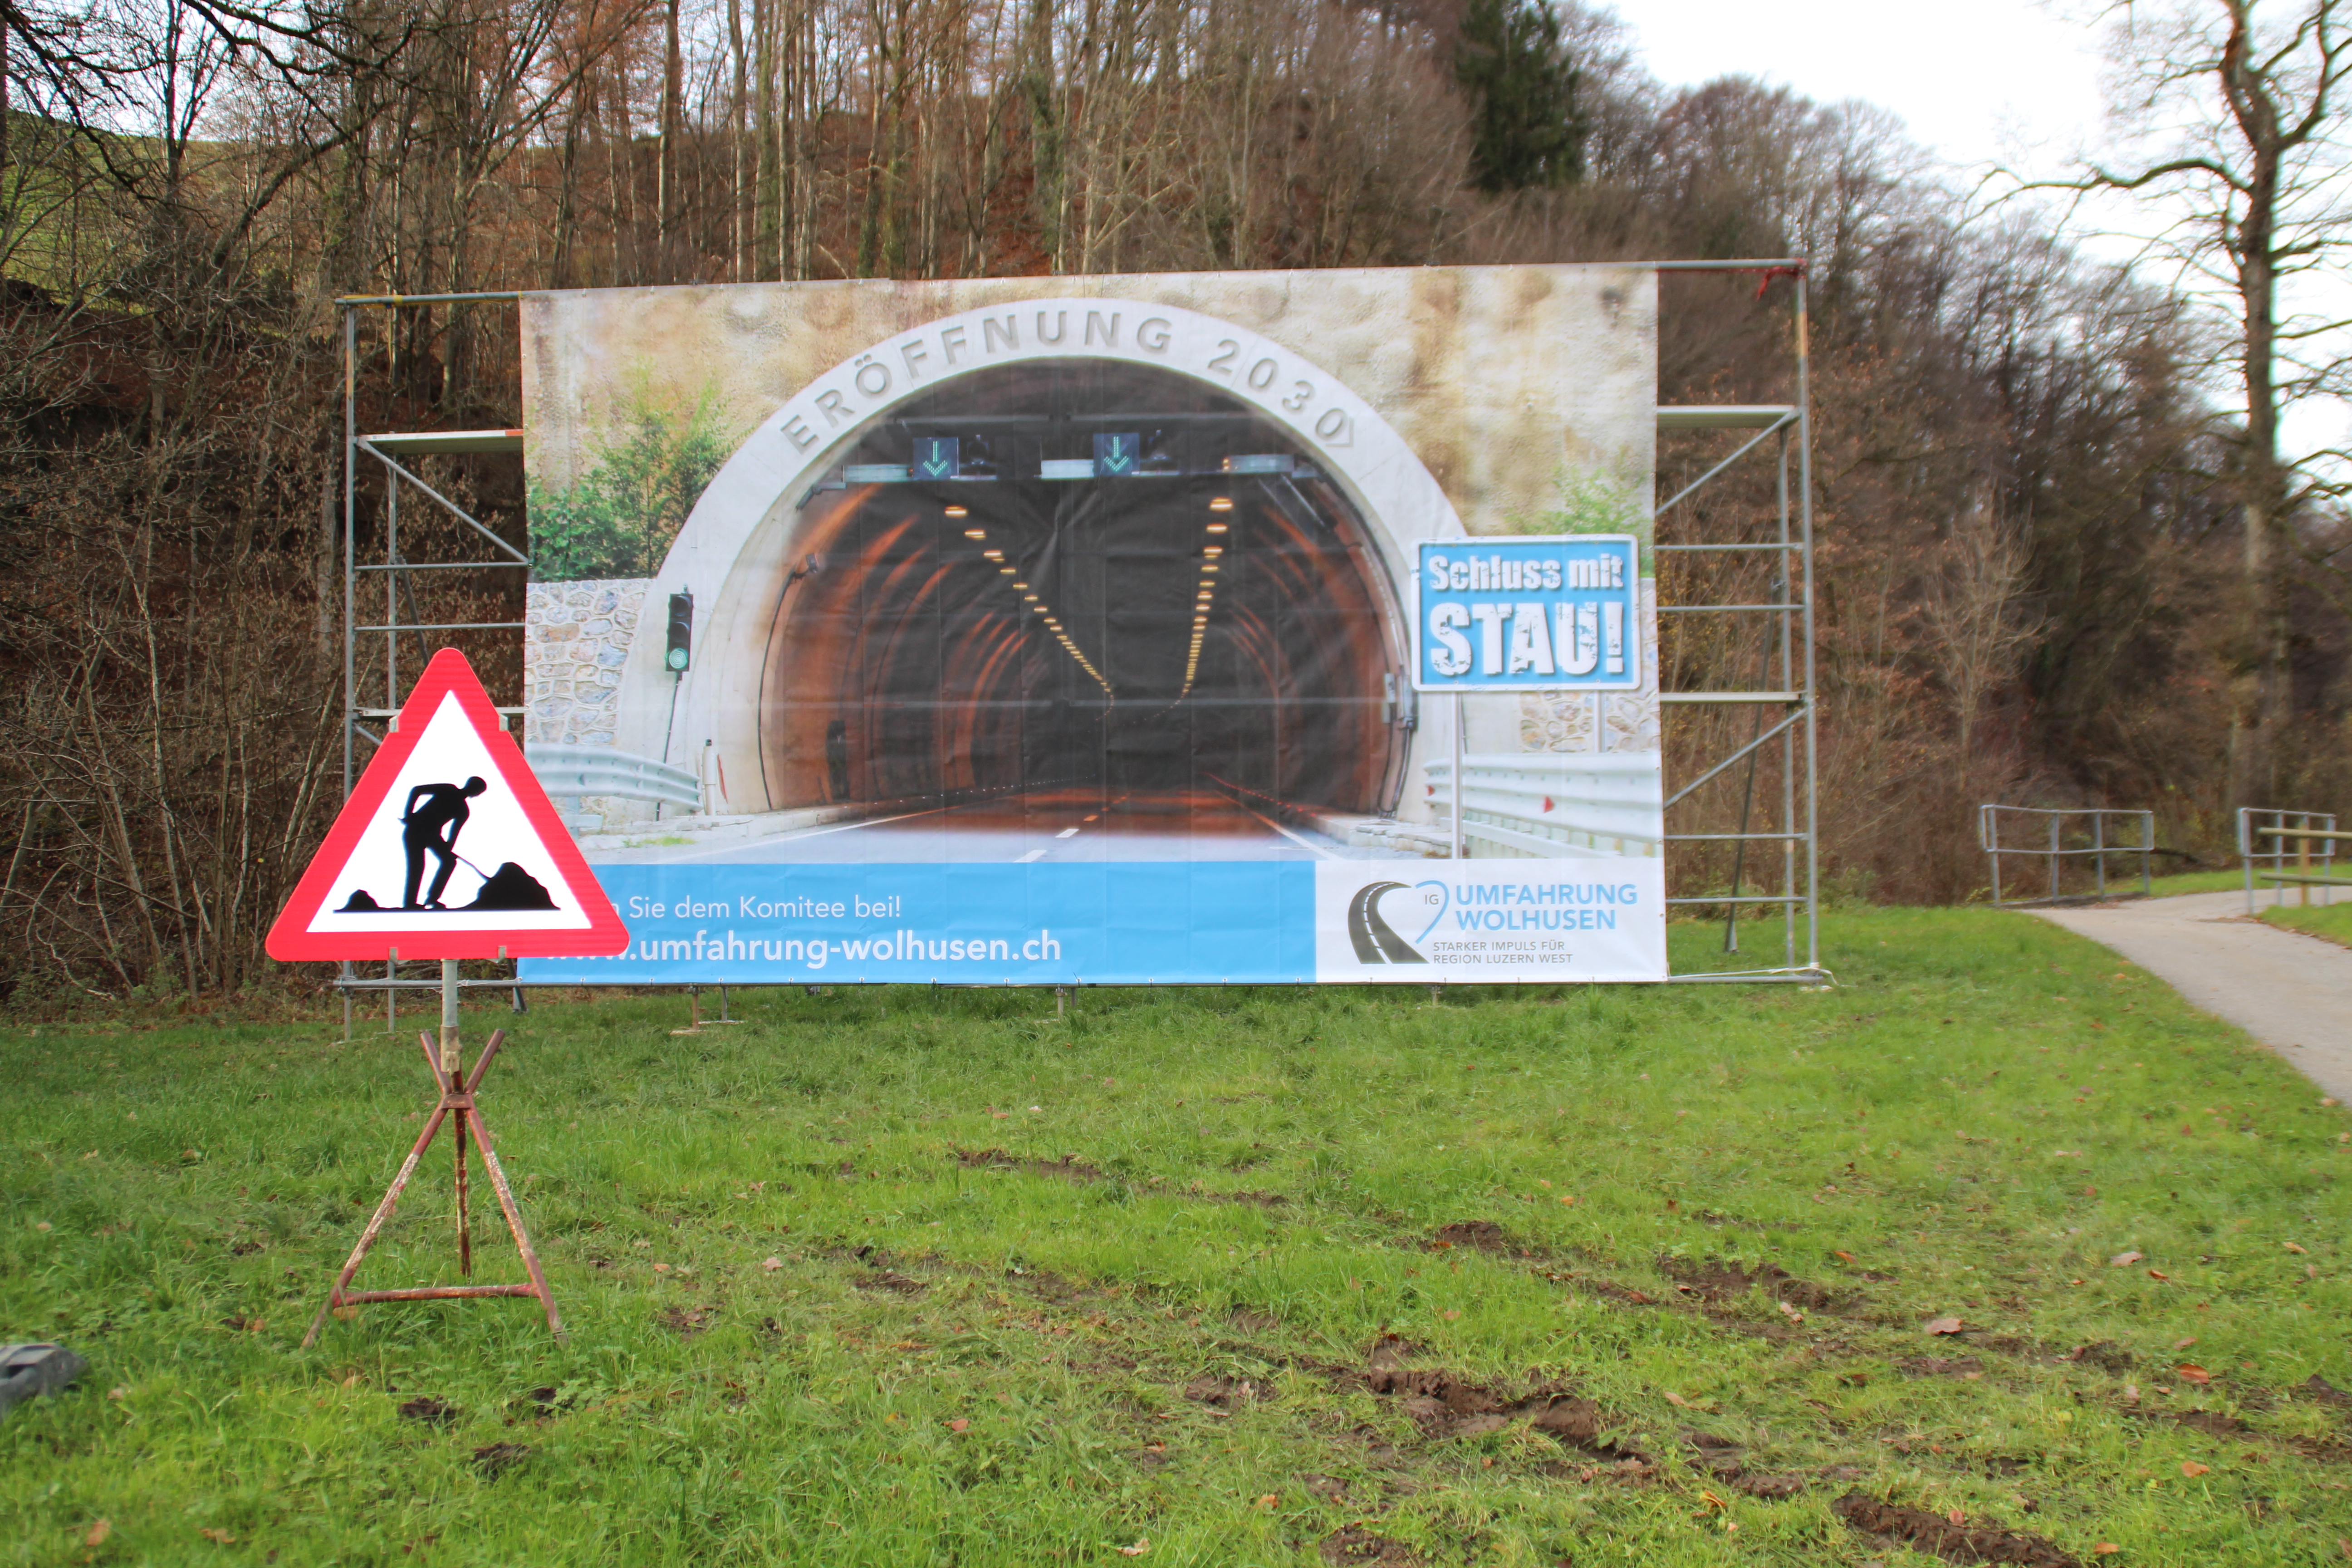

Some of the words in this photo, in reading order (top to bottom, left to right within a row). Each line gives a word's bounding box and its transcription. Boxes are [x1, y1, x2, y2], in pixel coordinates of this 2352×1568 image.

[780, 309, 1172, 455] ERÖFFNUNG
[1207, 338, 1348, 442] 2030
[1429, 555, 1562, 590] Schluss
[1568, 553, 1624, 588] mit
[1430, 601, 1624, 676] STAU!
[629, 896, 666, 918] Sie
[674, 895, 730, 918] dem
[740, 896, 845, 918] Komitee
[855, 894, 901, 918] bei!
[1424, 894, 1439, 905] IG
[1456, 884, 1638, 905] UMFAHRUNG
[1456, 909, 1616, 931] WOLHUSEN
[547, 929, 1060, 969] .umfahrung-wolhusen.ch
[1433, 941, 1487, 951] STARKER
[1492, 941, 1537, 951] IMPULS
[1542, 939, 1565, 951] FÜR
[1434, 954, 1481, 964] REGION
[1486, 954, 1534, 963] LUZERN
[1539, 953, 1573, 963] WEST
